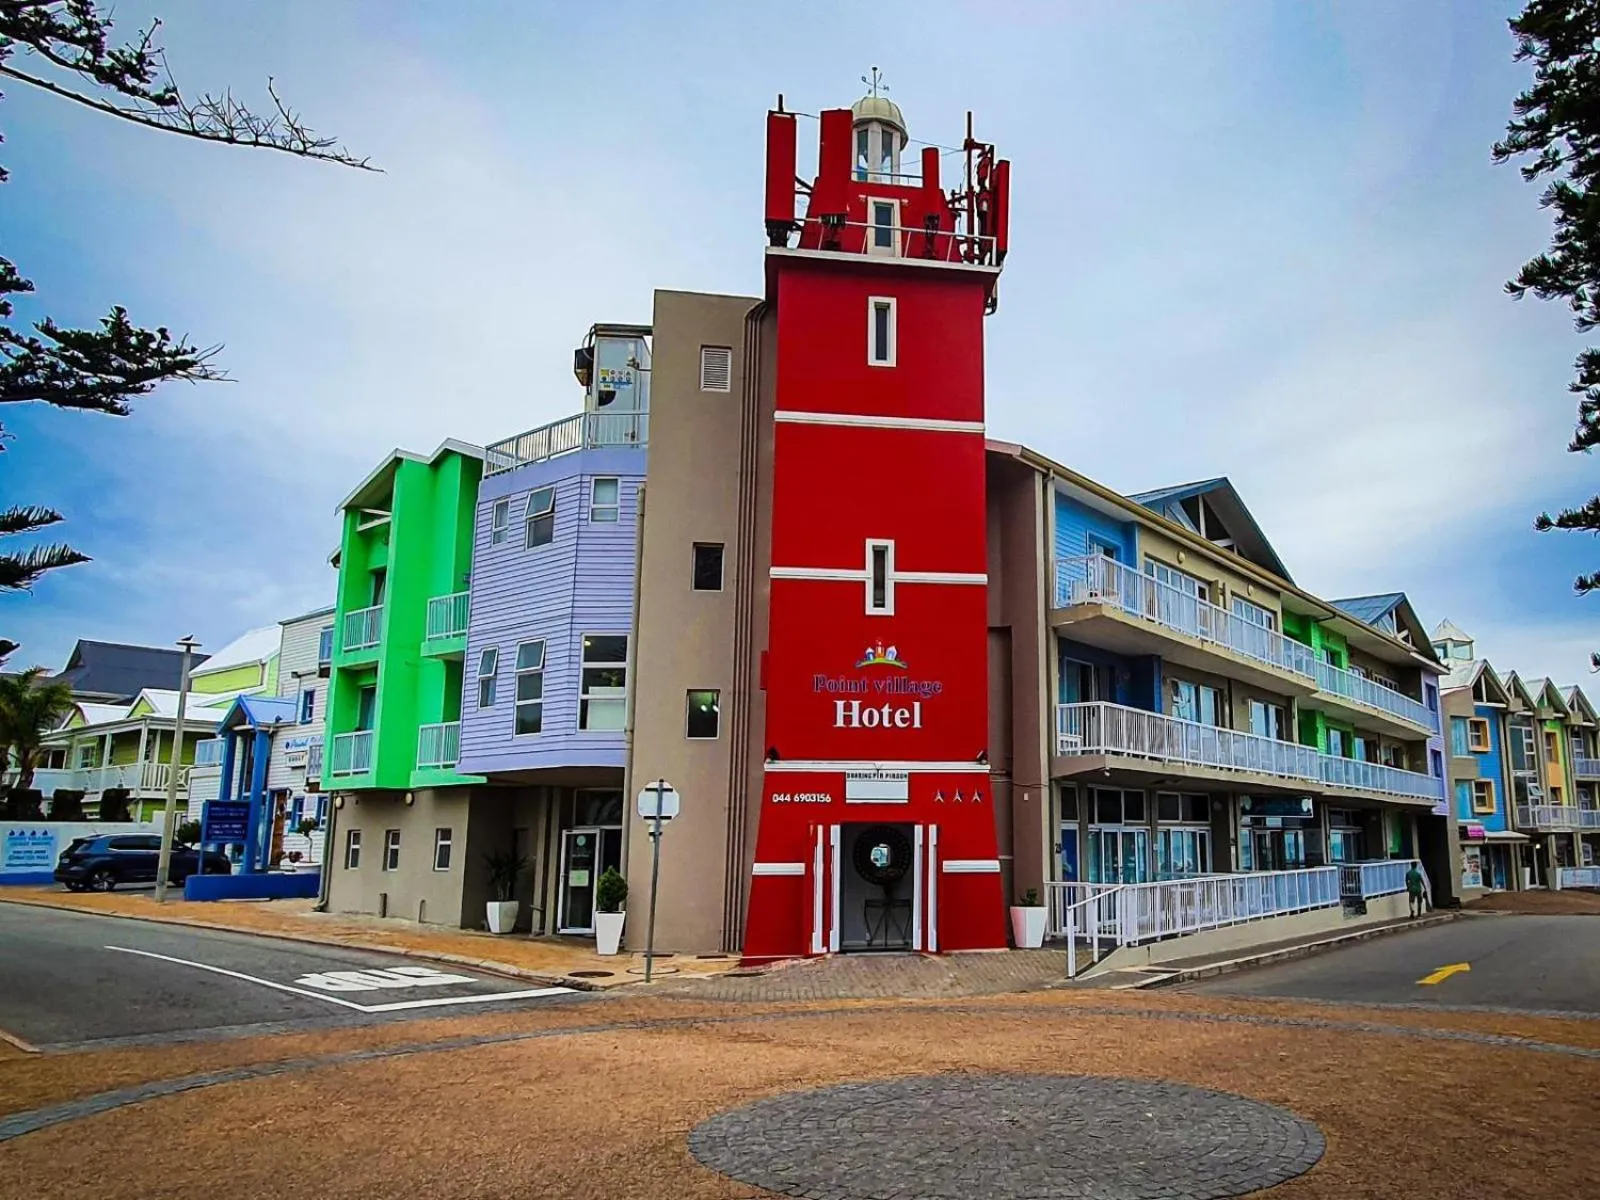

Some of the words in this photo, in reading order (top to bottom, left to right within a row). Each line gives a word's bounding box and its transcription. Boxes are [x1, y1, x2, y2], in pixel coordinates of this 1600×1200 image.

[813, 674, 868, 693] Point
[874, 676, 942, 698] village
[833, 699, 922, 728] Hotel
[772, 793, 791, 803] 044
[793, 793, 832, 803] 6903156
